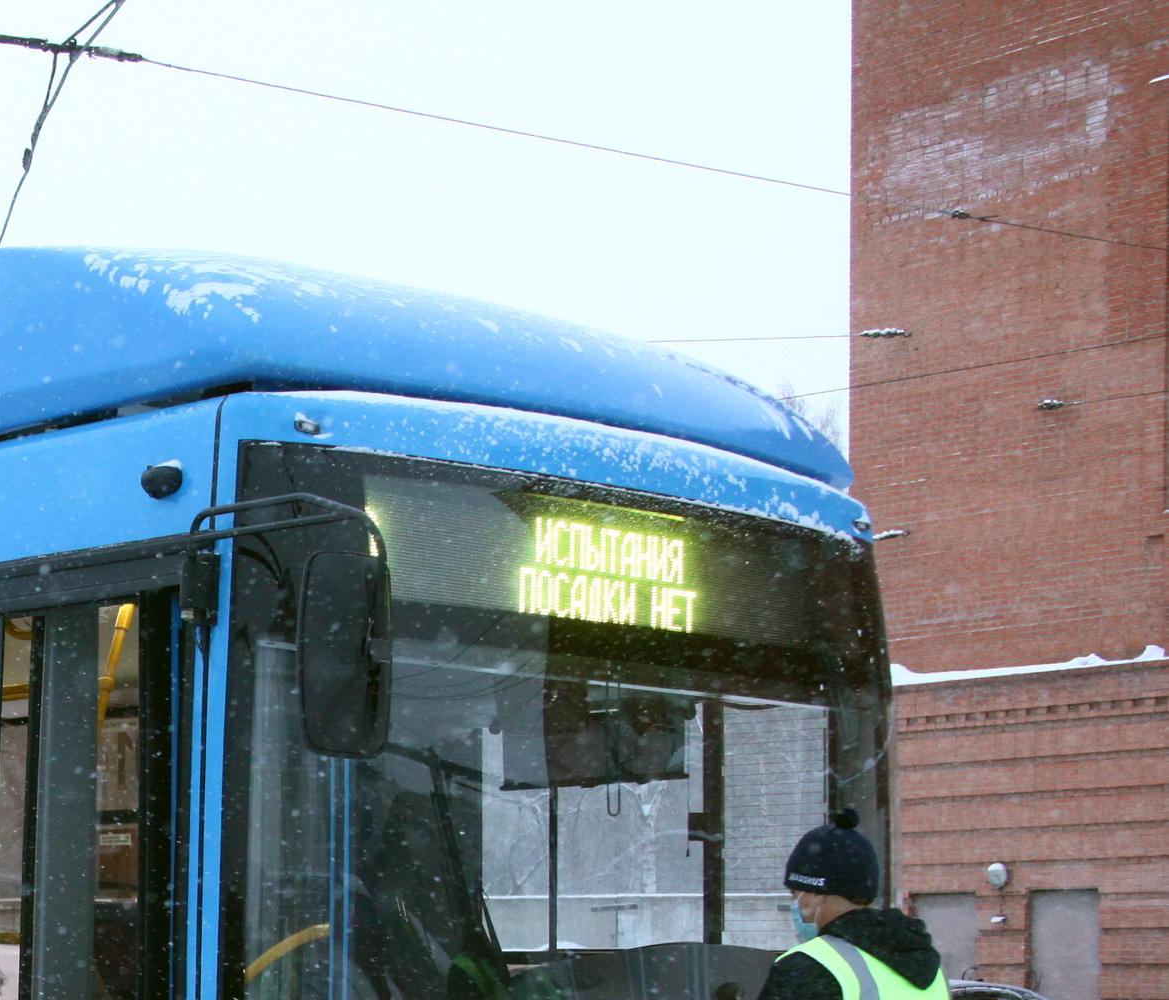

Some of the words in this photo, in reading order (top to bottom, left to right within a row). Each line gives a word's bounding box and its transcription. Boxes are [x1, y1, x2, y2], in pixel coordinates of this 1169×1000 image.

[534, 516, 685, 584] ИСПЫТАНИЯ
[518, 566, 637, 626] ПОСАДКИ
[650, 586, 697, 633] НЕТ
